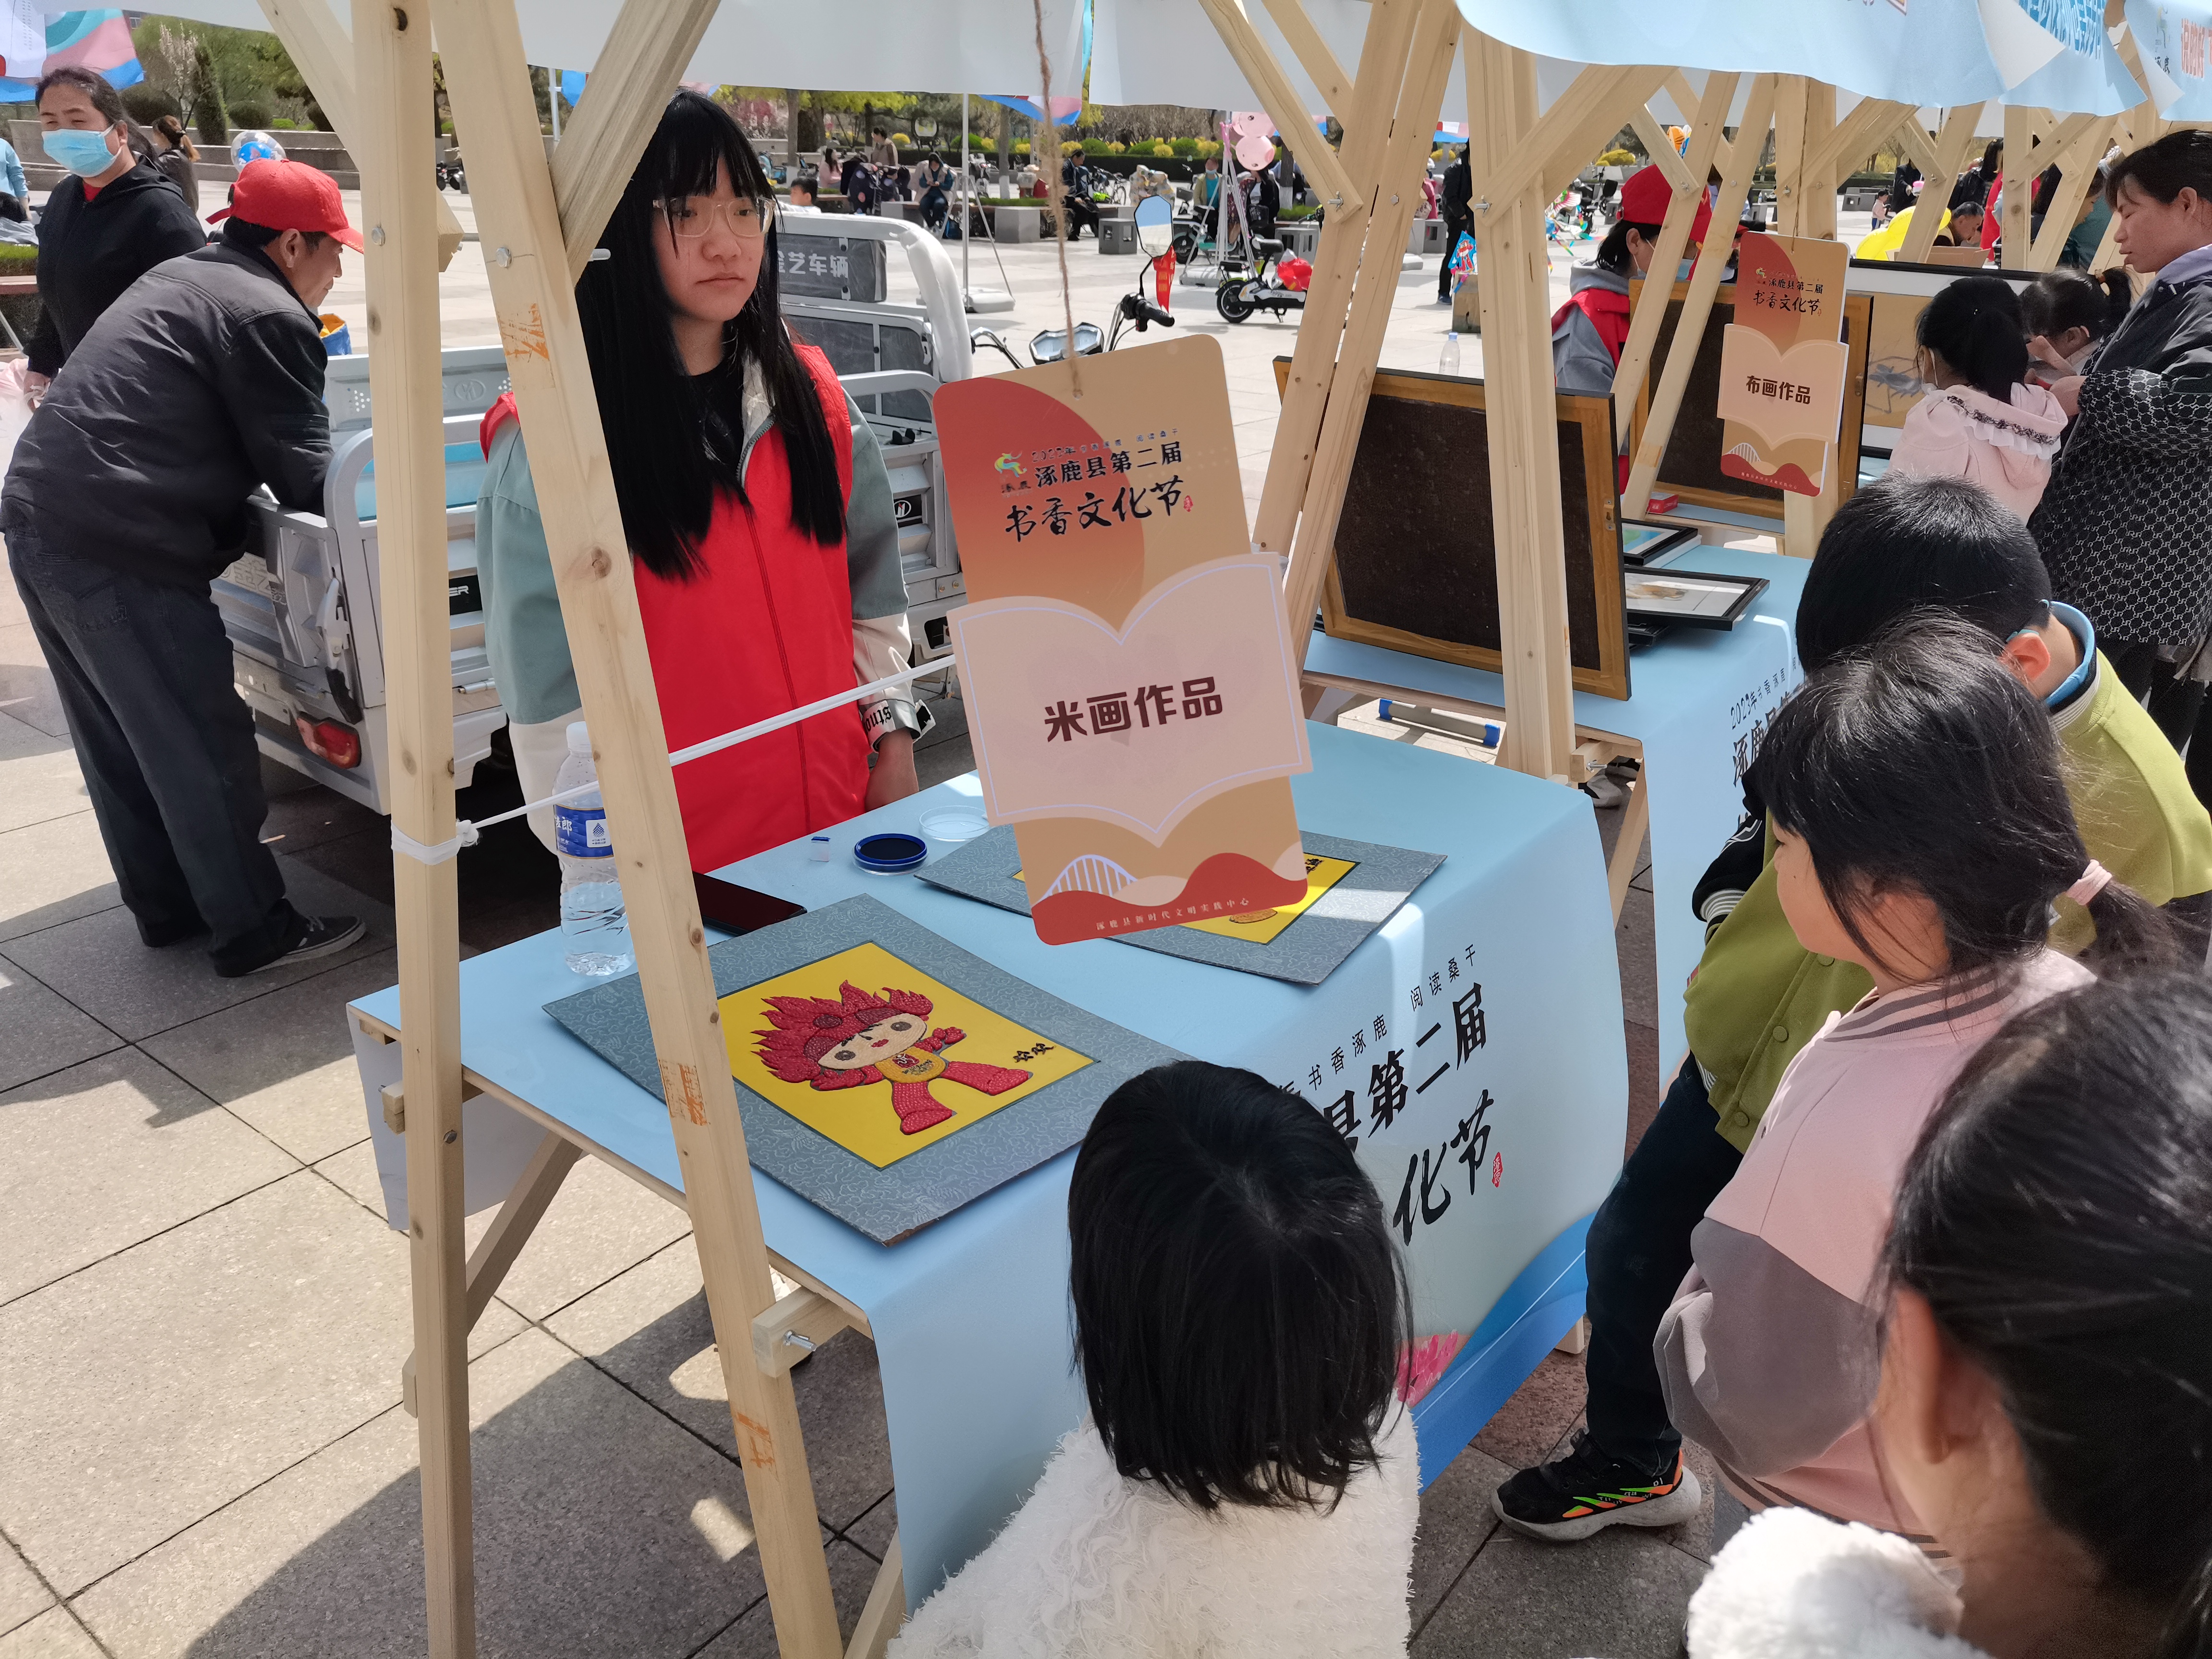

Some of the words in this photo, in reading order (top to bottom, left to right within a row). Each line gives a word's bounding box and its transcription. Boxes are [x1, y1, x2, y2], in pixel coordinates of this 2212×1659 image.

[1753, 290, 1821, 315] 书香文化节
[1768, 278, 1823, 294] 涿鹿县第二届
[1746, 375, 1811, 405] 布画作品
[1034, 441, 1182, 488] 涿鹿县第二届
[1005, 475, 1183, 542] 书香文化节
[1044, 676, 1224, 743] 米画作品
[1410, 944, 1476, 1011] 阅读桑干
